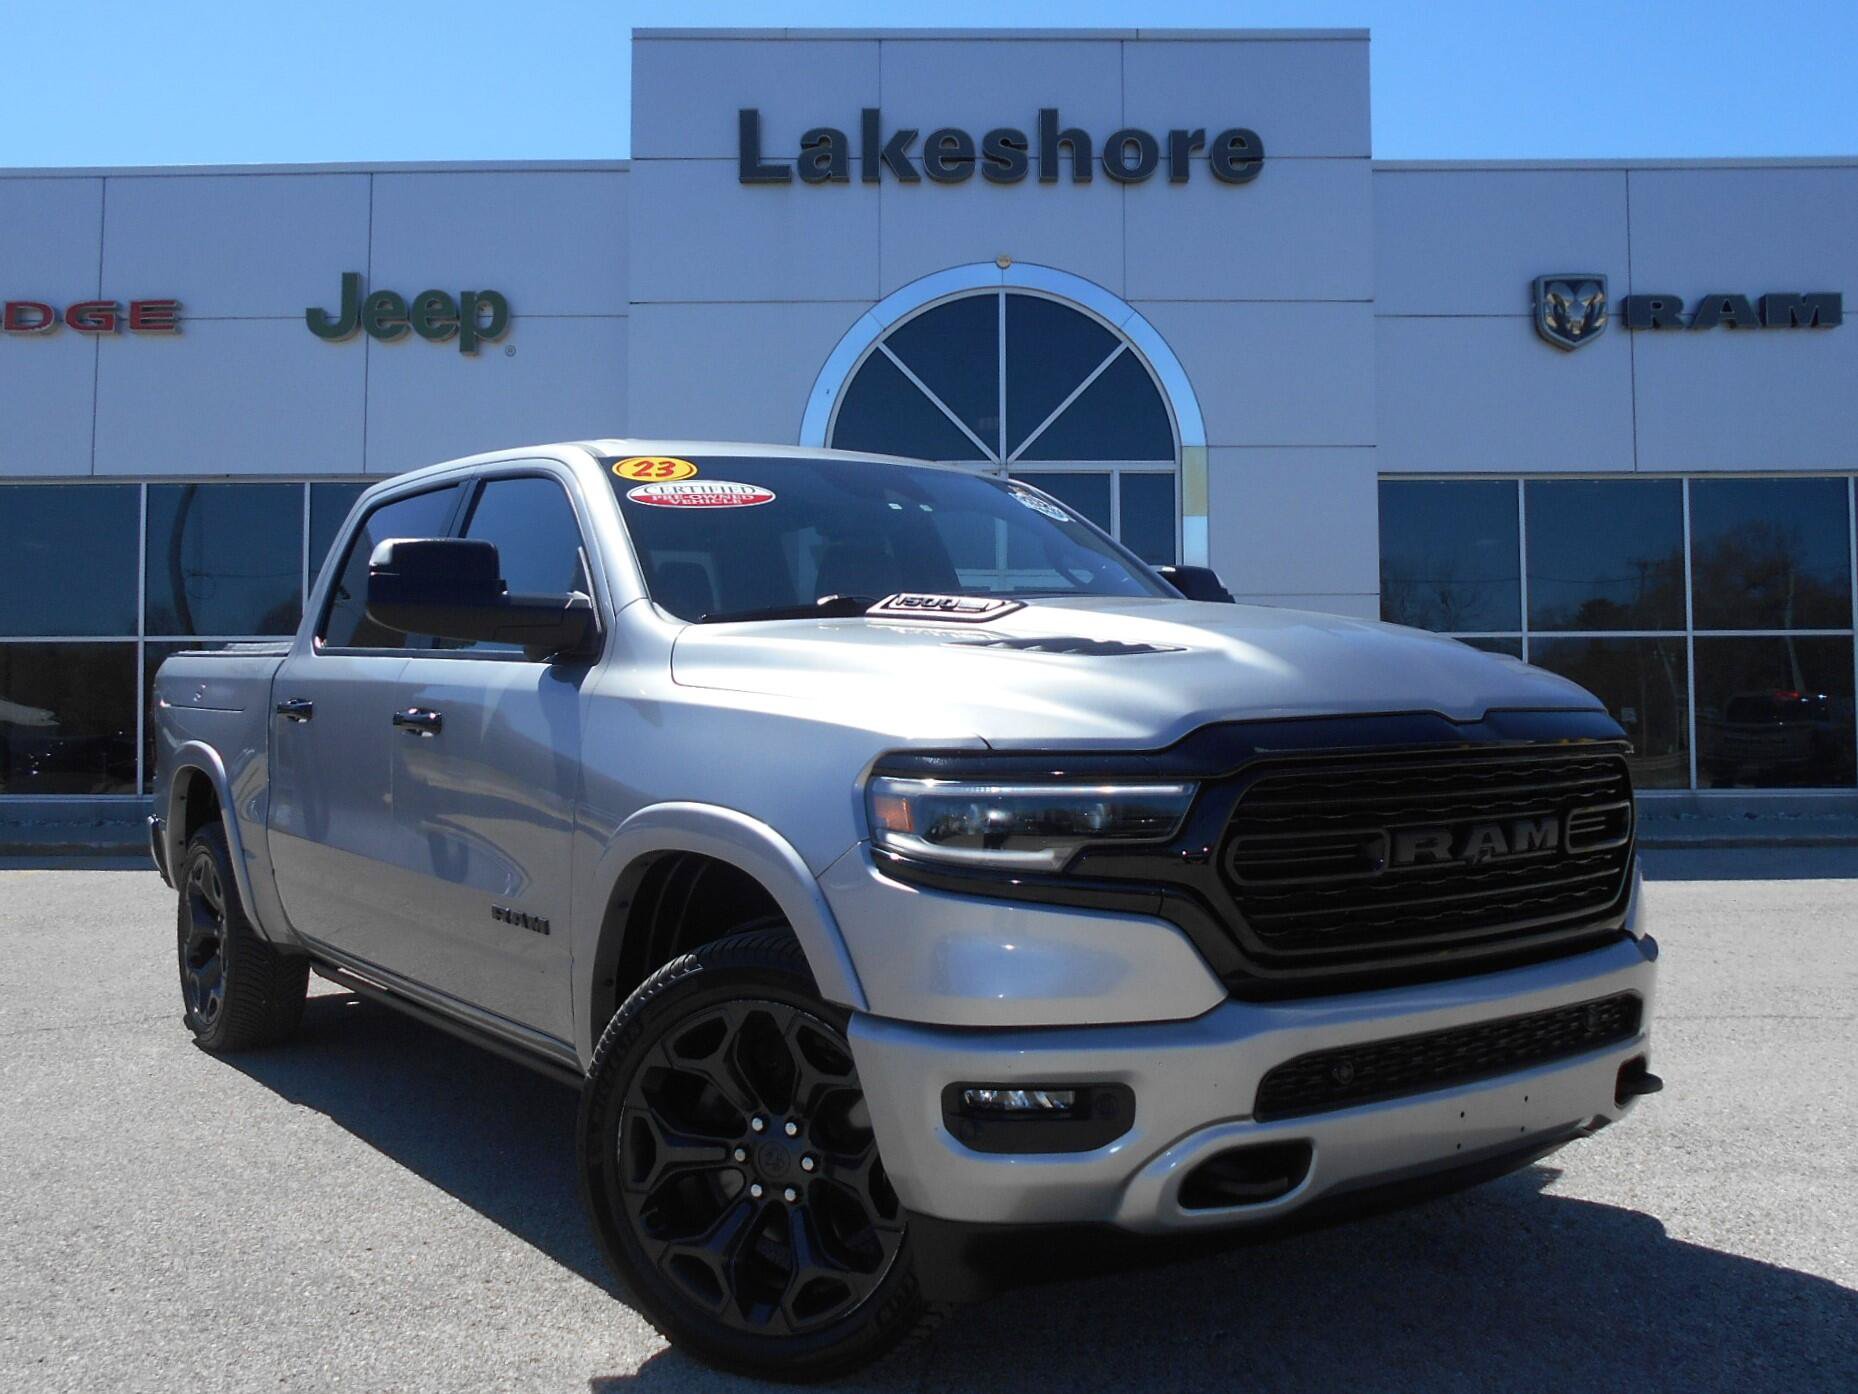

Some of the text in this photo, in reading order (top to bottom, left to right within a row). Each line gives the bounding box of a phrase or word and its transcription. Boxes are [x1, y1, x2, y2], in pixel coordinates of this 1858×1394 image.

[738, 107, 1265, 184] Lakeshore
[305, 271, 513, 357] Jeep
[1620, 291, 1843, 330] RAM
[631, 460, 677, 478] 23
[643, 484, 757, 495] CERTIFIED
[651, 493, 755, 502] PRE-OWNED
[1394, 816, 1559, 864] RAM
[491, 903, 551, 936] RAM
